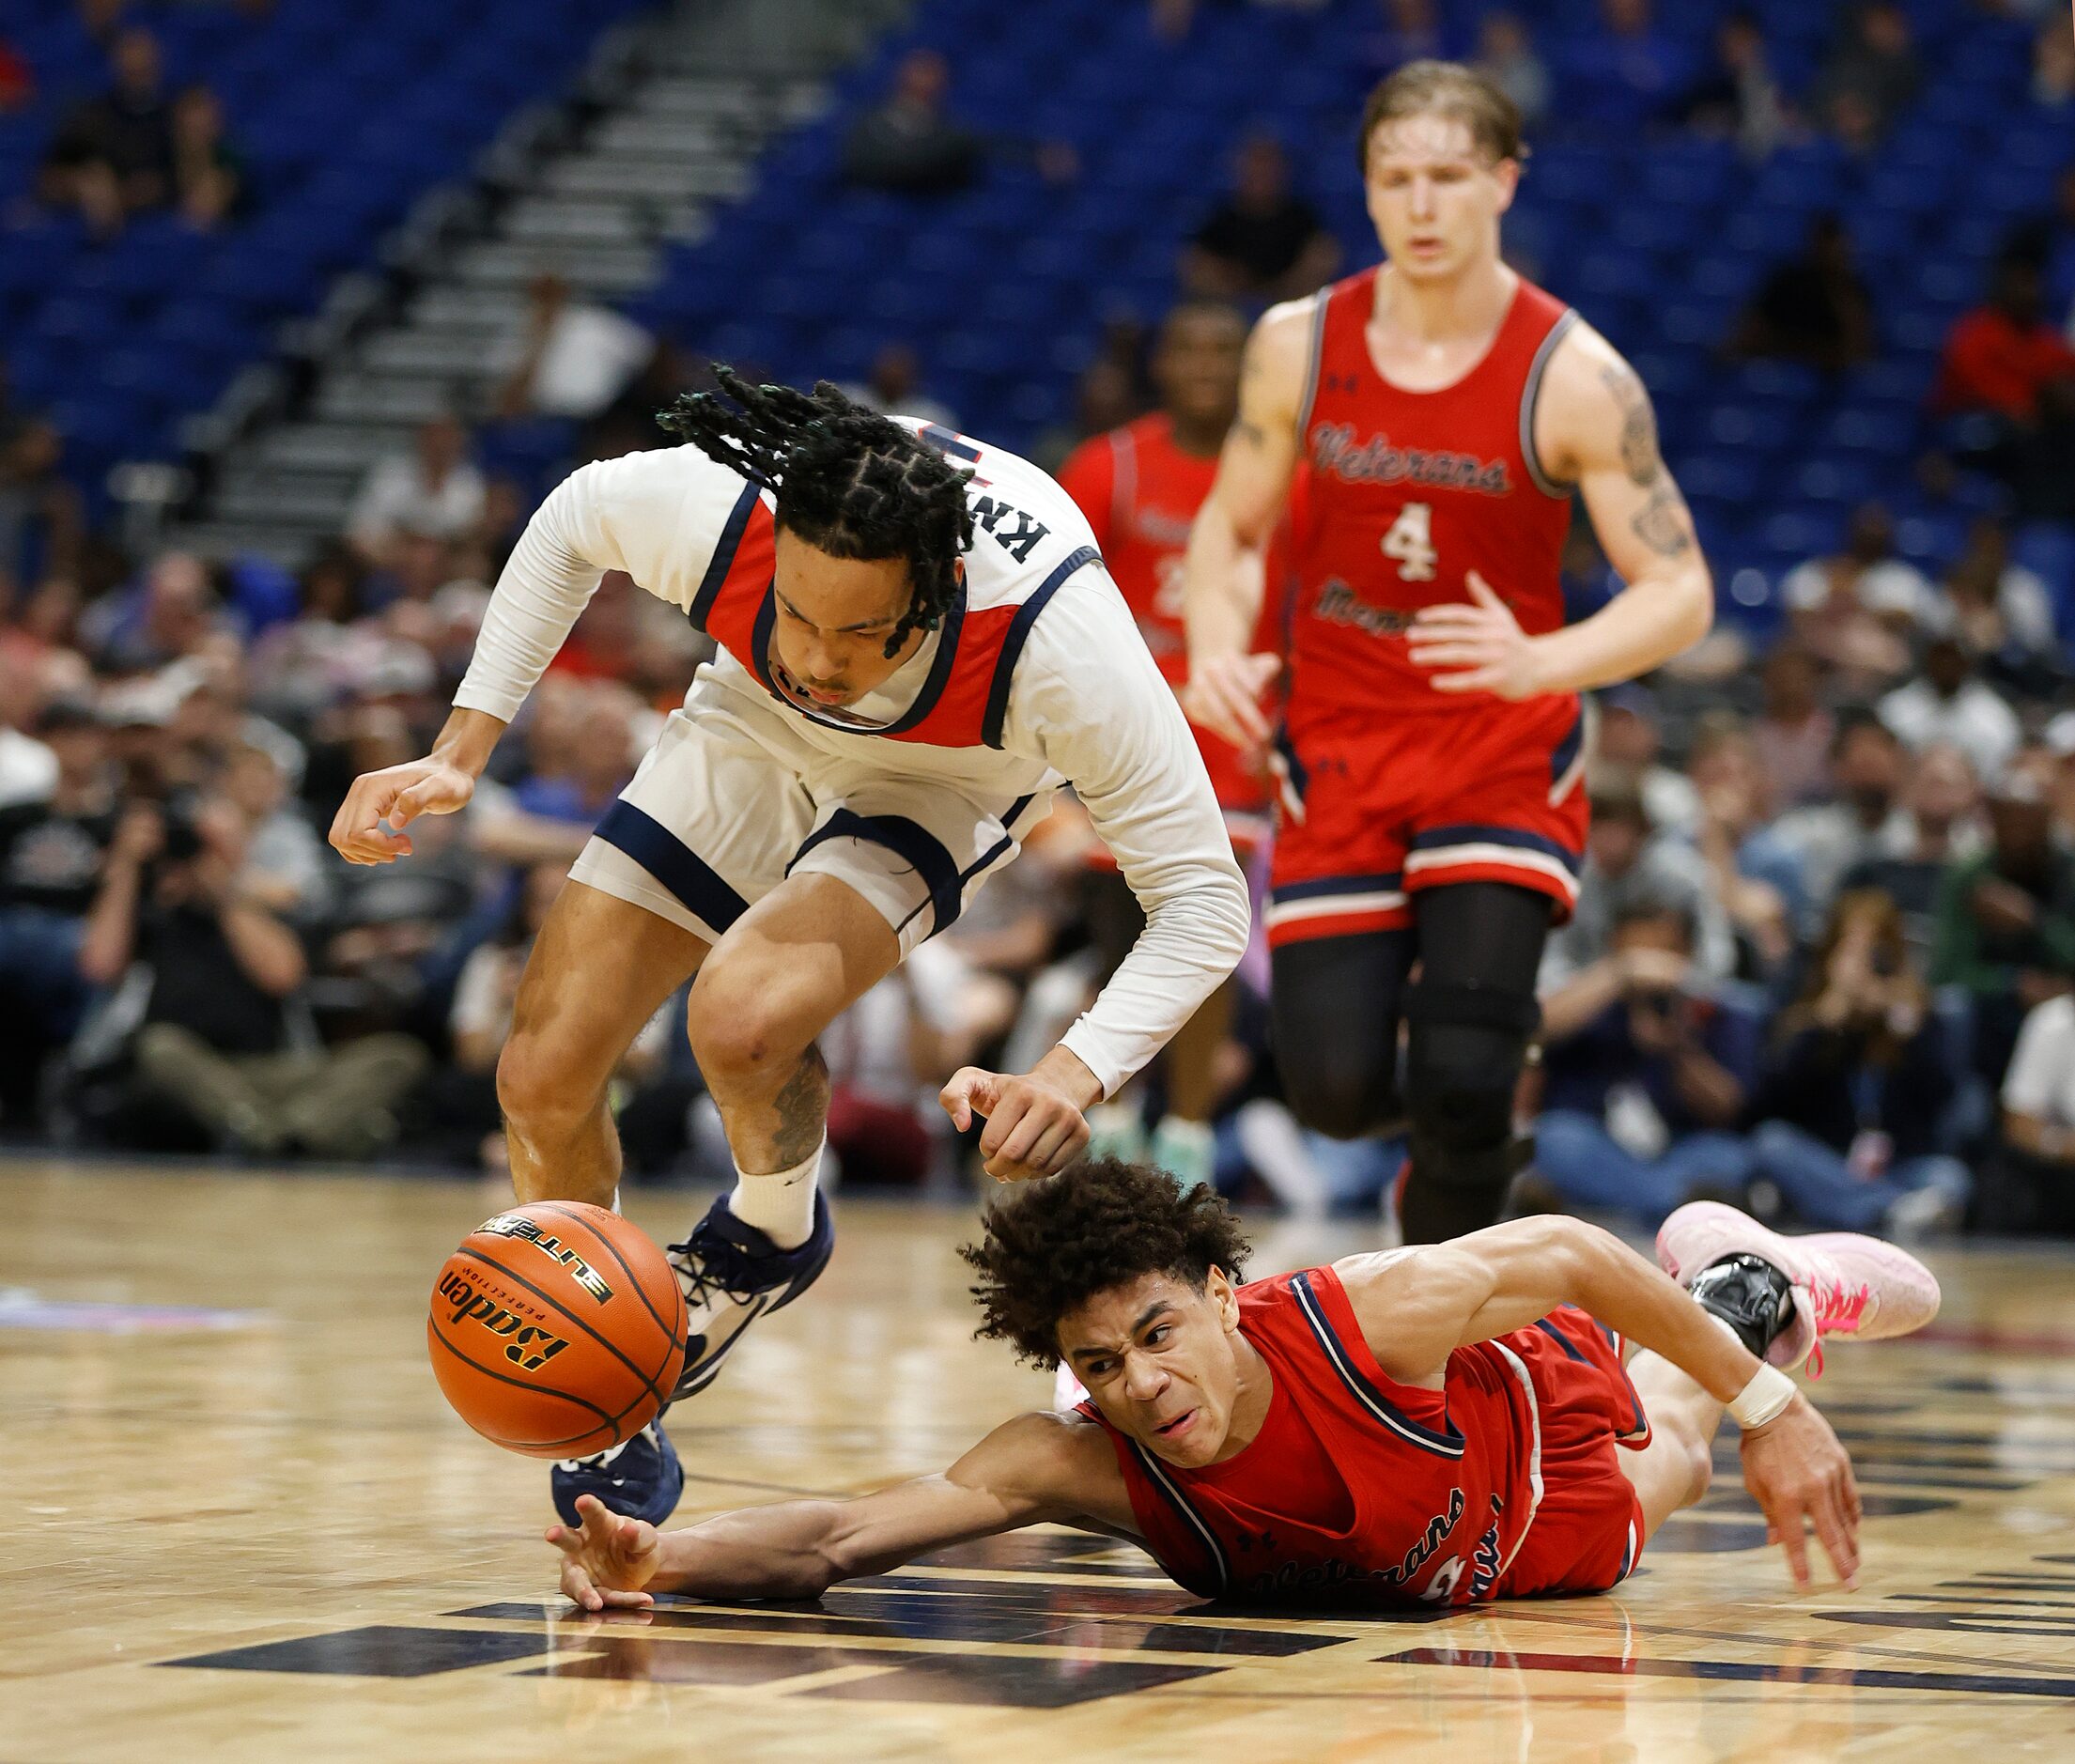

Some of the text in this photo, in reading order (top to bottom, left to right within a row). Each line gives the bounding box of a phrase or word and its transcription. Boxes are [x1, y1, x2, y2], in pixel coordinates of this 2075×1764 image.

[1311, 421, 1510, 497] Veterans
[967, 491, 1051, 565] KN
[1380, 502, 1438, 582] 4
[439, 1270, 571, 1372] Baden
[462, 1266, 546, 1322] PERFECTION
